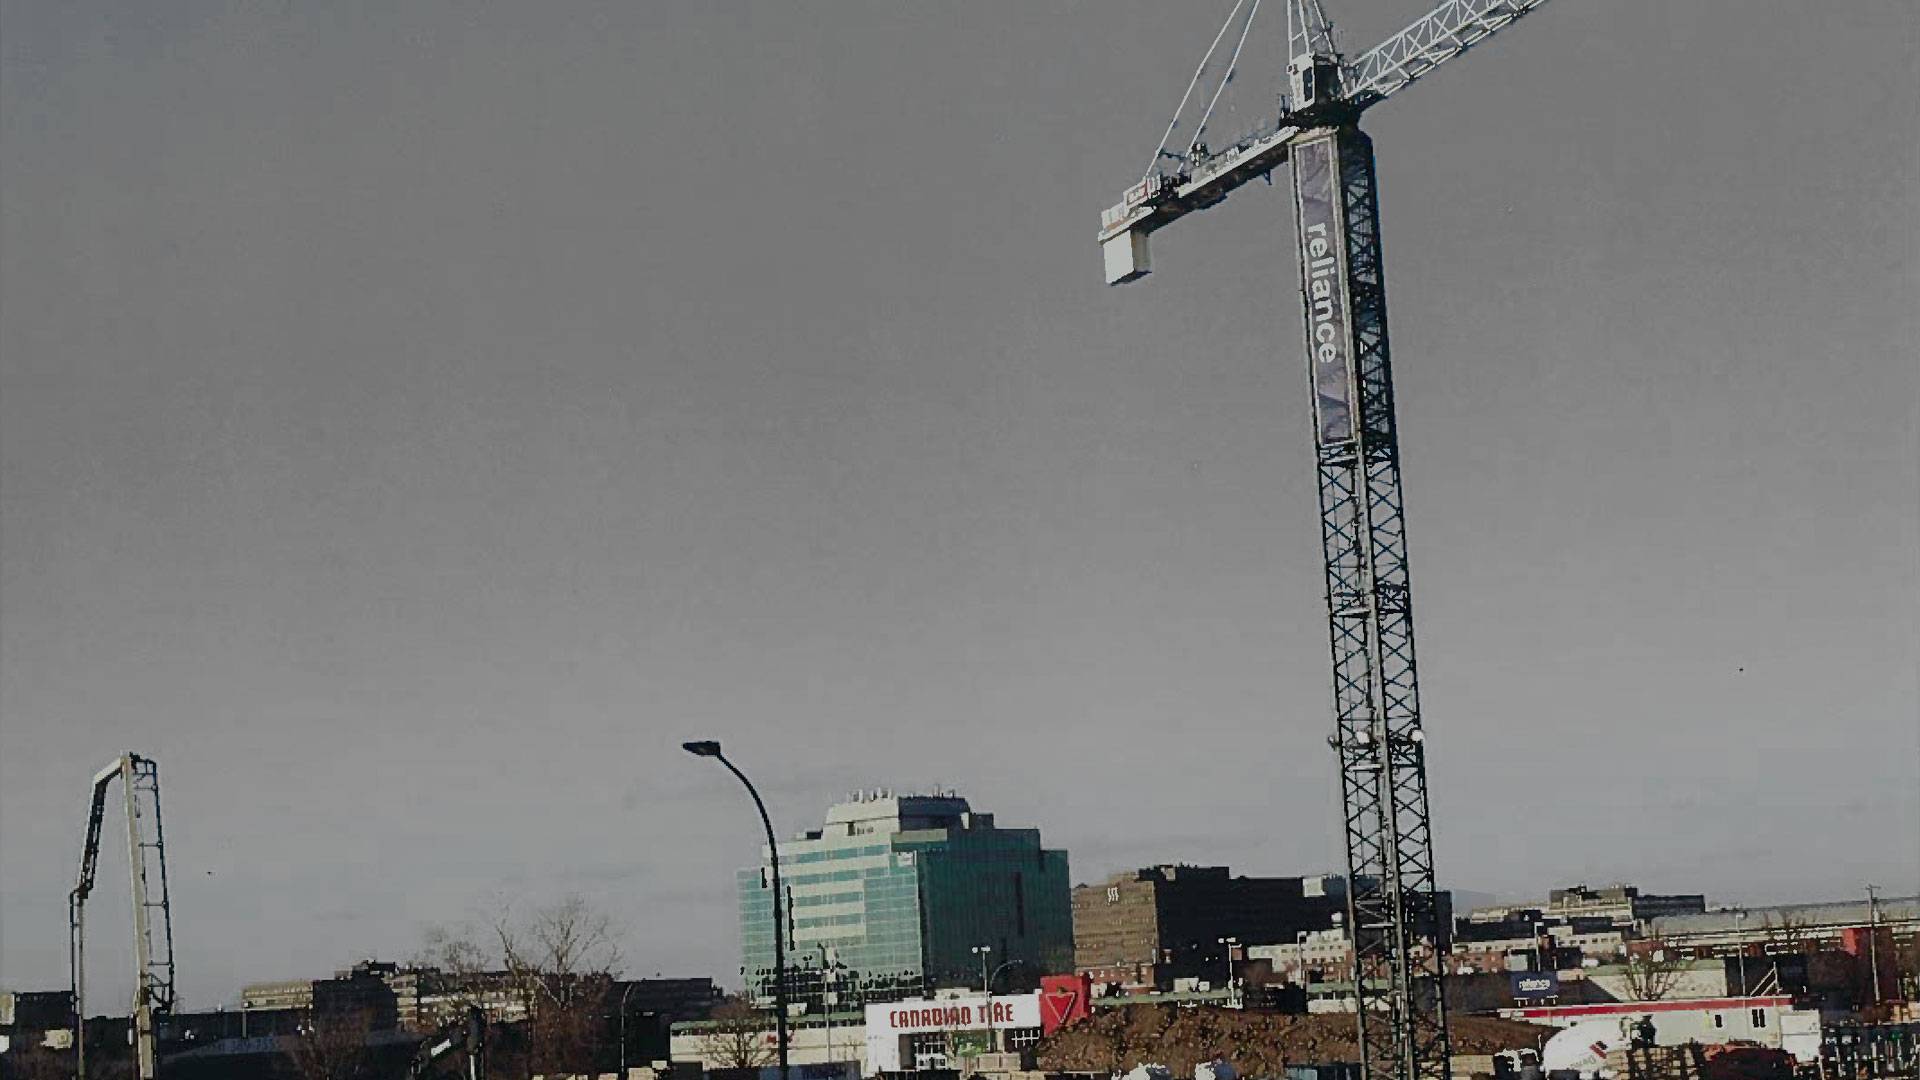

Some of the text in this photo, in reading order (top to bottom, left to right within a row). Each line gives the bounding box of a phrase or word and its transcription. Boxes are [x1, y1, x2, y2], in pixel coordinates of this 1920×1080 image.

[1308, 223, 1336, 363] reliance
[890, 1002, 1014, 1028] CANADIAN TRE
